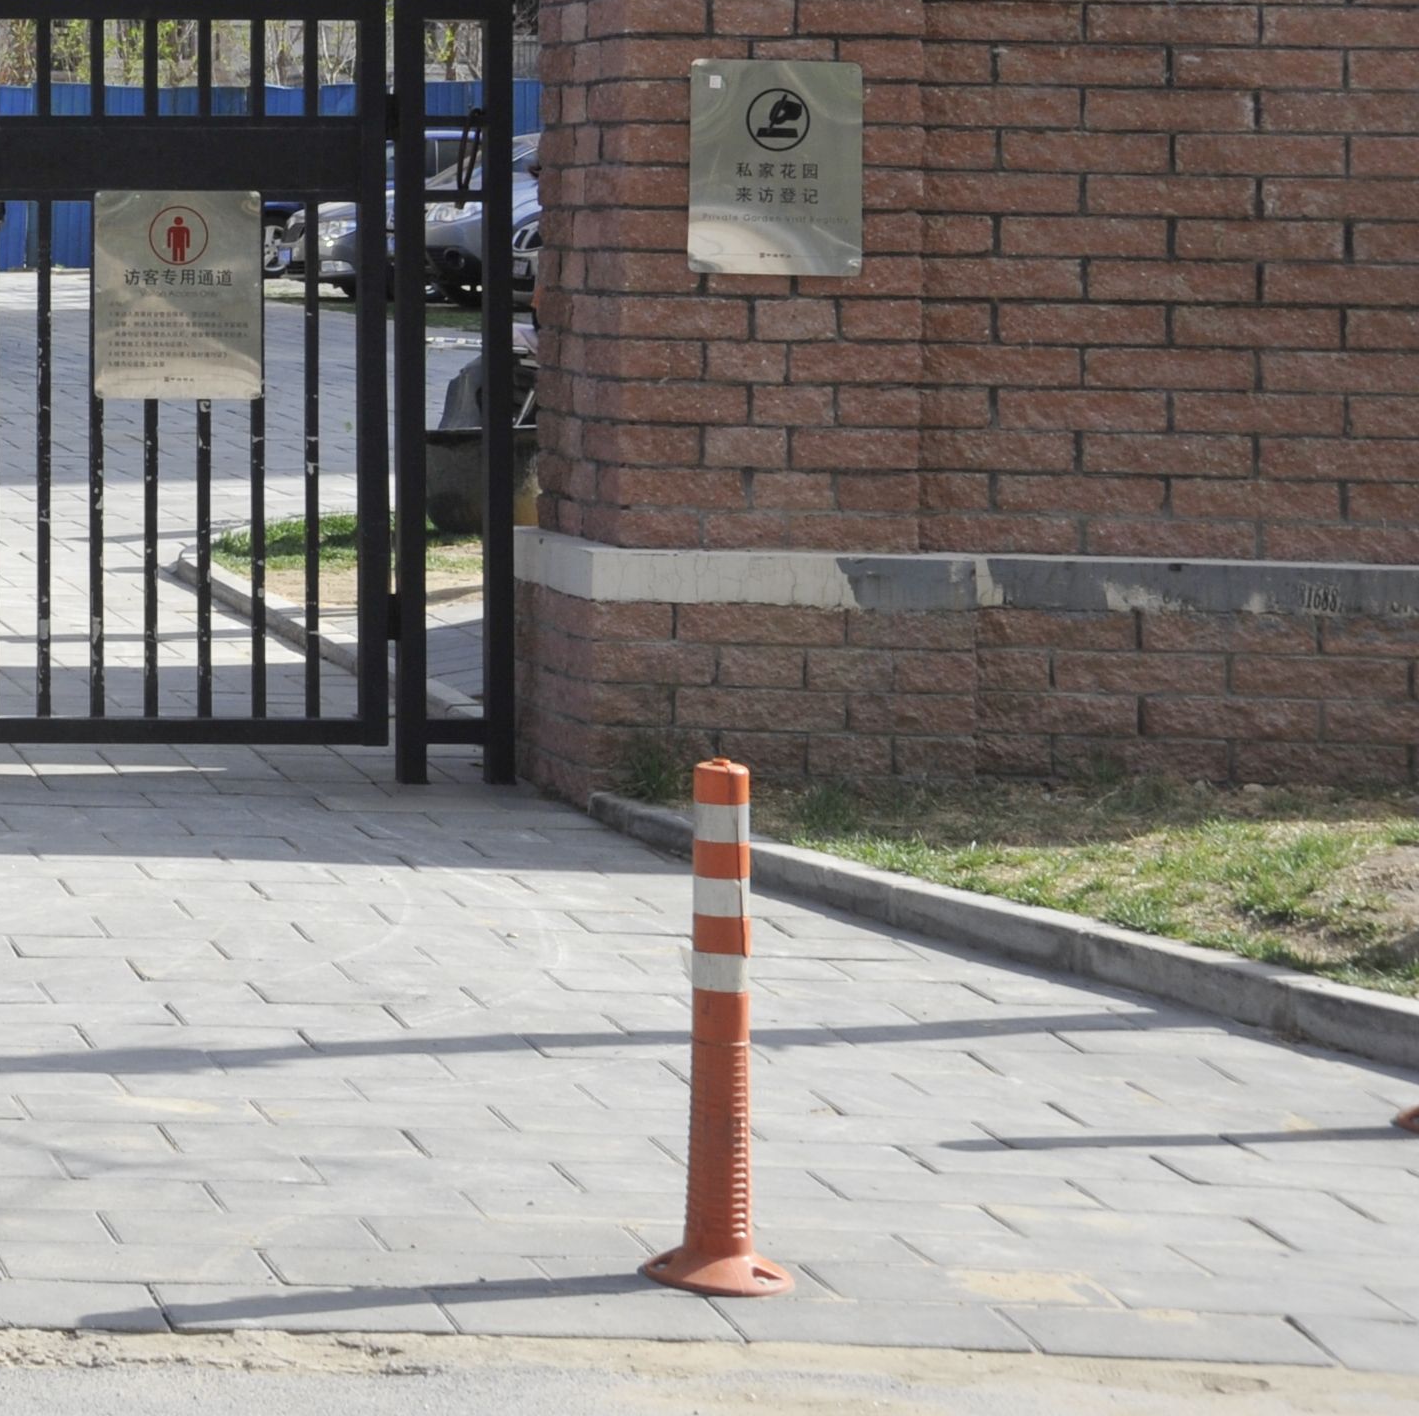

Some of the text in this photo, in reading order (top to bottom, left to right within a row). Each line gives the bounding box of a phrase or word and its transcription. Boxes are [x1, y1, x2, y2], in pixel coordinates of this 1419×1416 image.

[735, 162, 819, 179] 私家花园
[735, 187, 819, 204] 来访登记
[702, 213, 738, 222] Private
[743, 214, 781, 222] Garden
[124, 269, 233, 286] 访客专用通道
